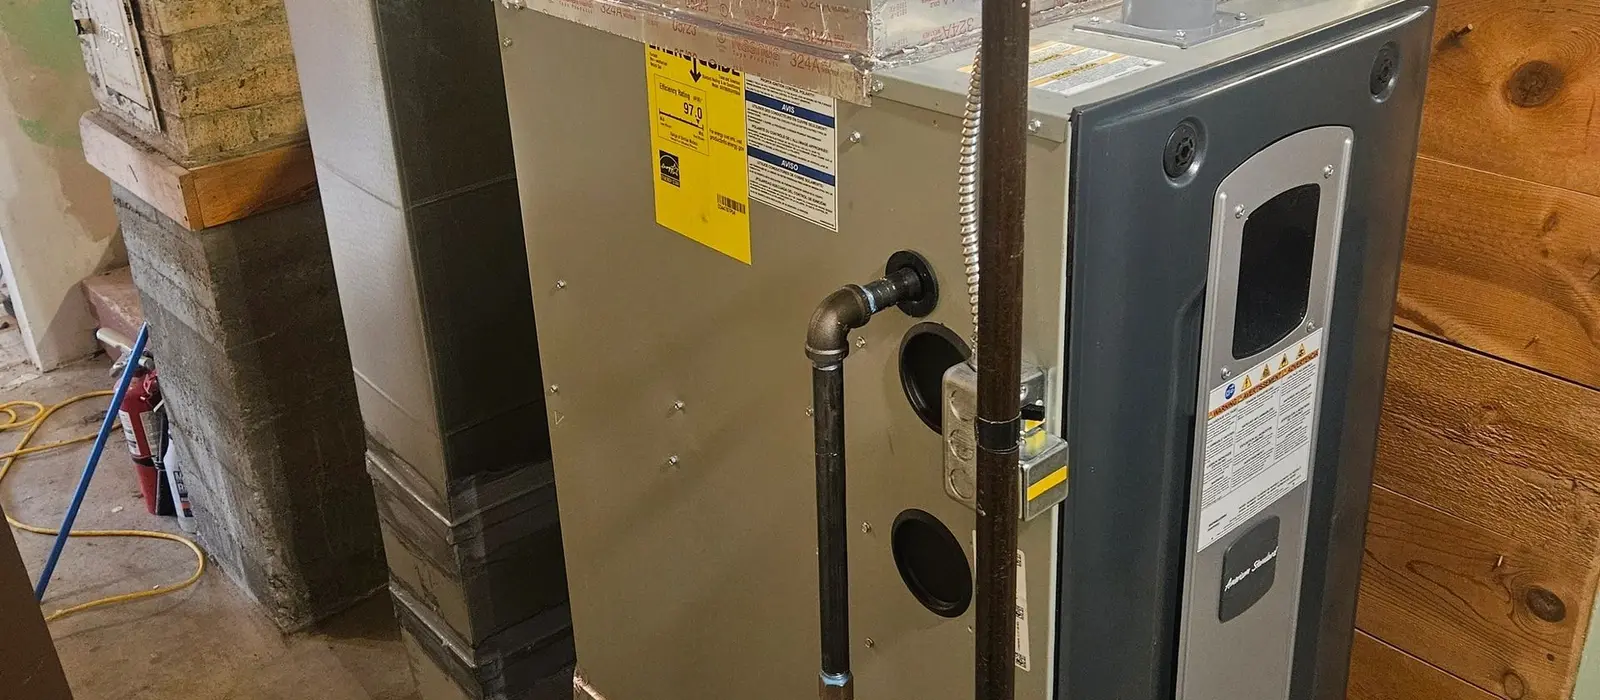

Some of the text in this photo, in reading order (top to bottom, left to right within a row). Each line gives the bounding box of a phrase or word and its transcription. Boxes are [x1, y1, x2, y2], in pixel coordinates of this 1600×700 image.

[600, 4, 623, 17] 324A
[942, 17, 974, 36] 324A
[790, 53, 820, 73] 324A
[659, 82, 678, 96] Efficiency
[678, 89, 690, 101] Rating
[683, 102, 702, 120] 97.0
[781, 103, 795, 114] AVIS
[781, 160, 798, 171] AVISO
[1224, 546, 1279, 592] American Standard
